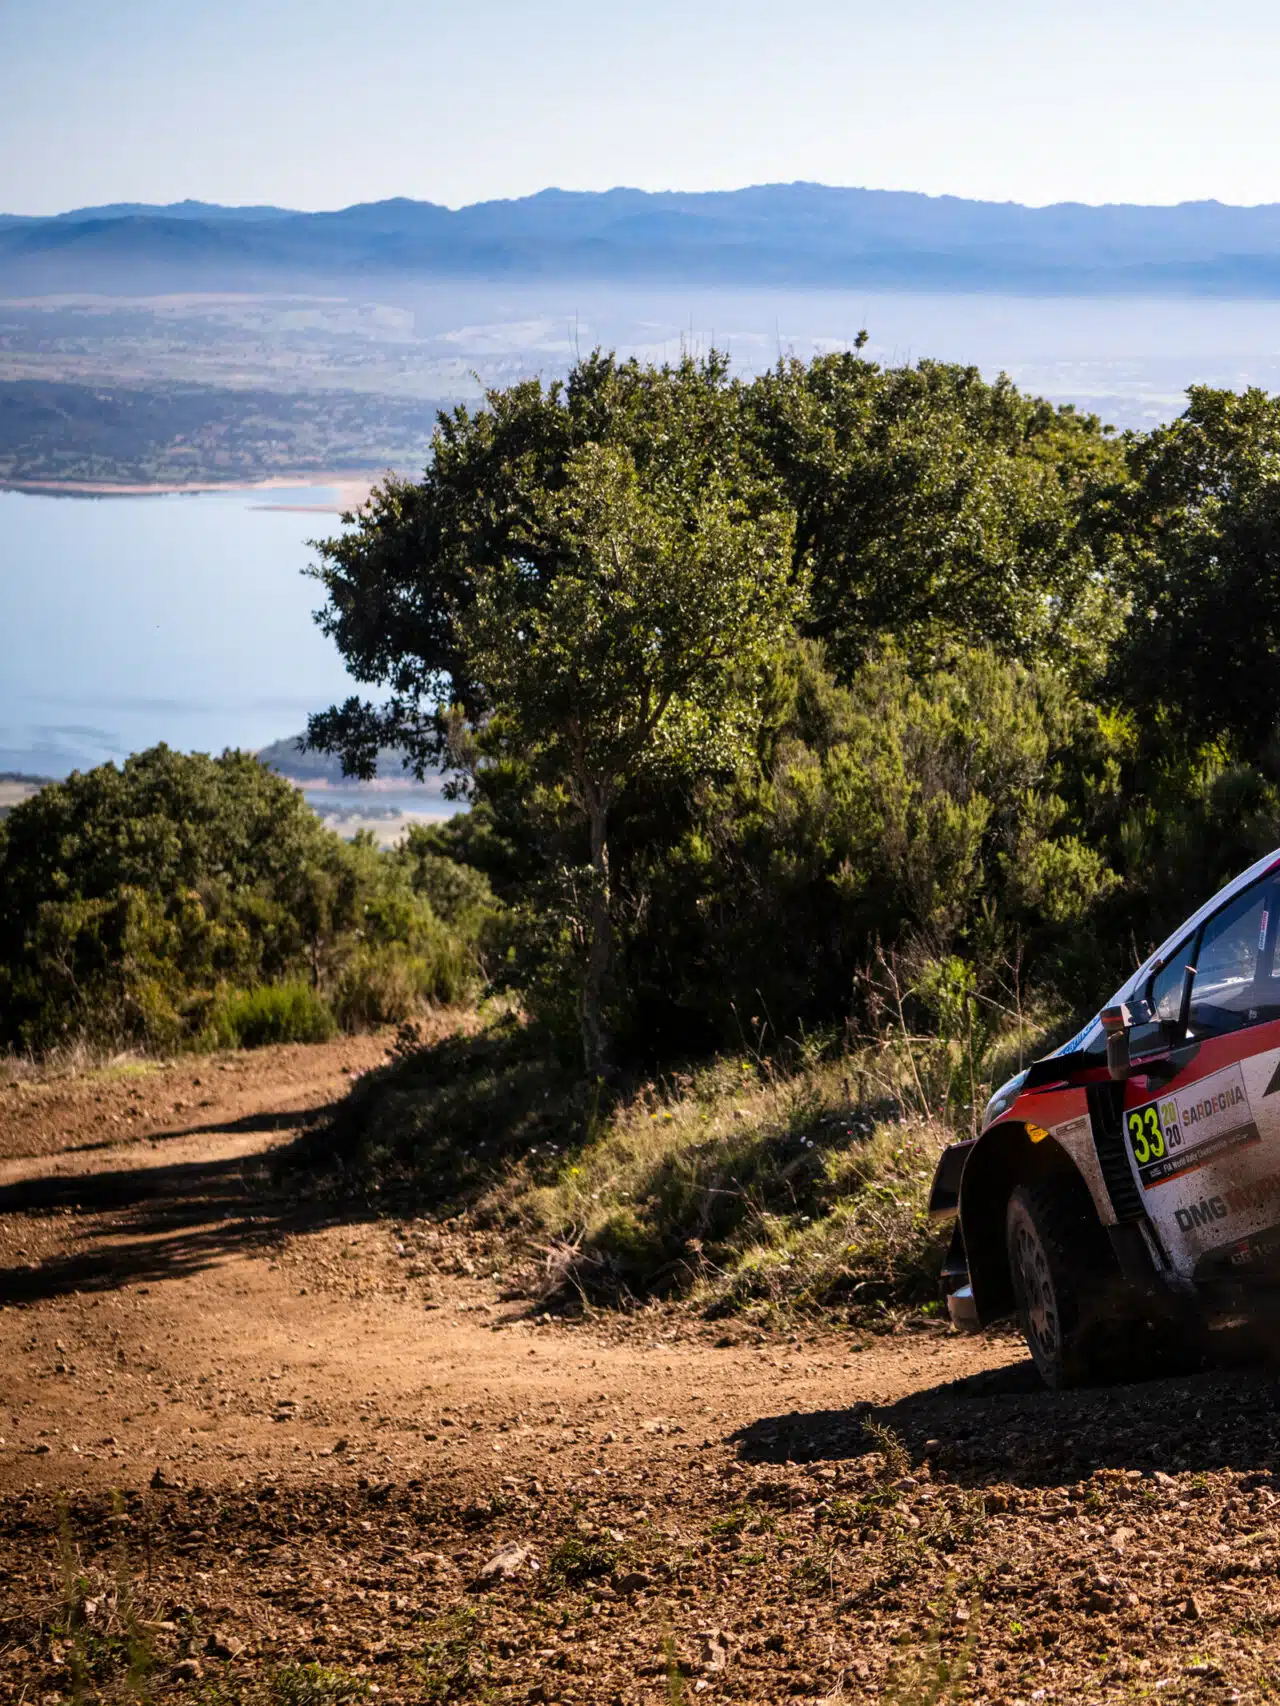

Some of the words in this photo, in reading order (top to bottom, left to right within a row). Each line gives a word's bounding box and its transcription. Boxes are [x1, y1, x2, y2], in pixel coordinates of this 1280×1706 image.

[1161, 1101, 1177, 1127] 20
[1182, 1086, 1244, 1127] SARDEGNA
[1128, 1107, 1165, 1163] 33
[1165, 1124, 1182, 1149] 20
[1174, 1195, 1228, 1233] DMG
